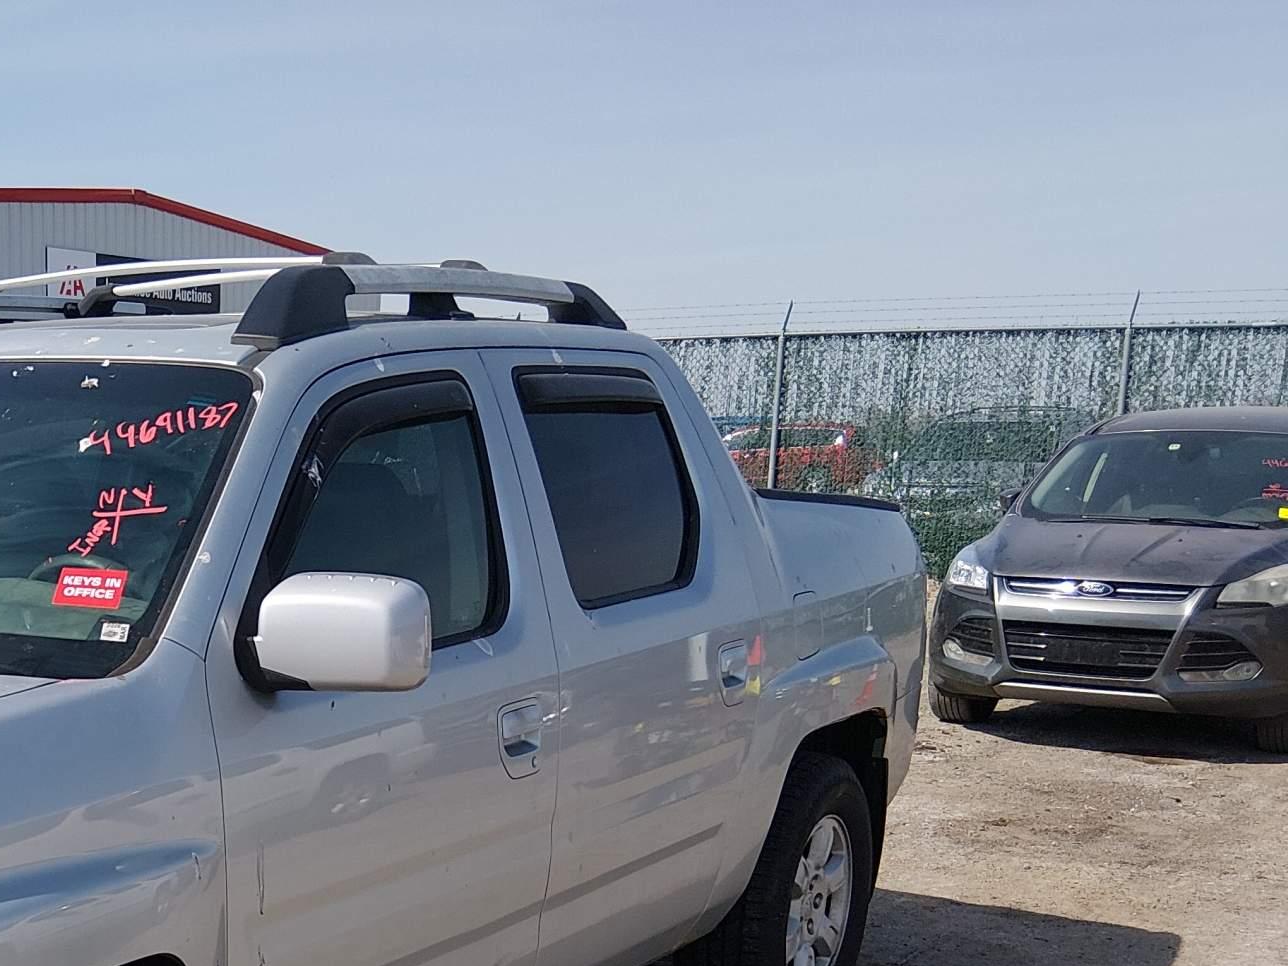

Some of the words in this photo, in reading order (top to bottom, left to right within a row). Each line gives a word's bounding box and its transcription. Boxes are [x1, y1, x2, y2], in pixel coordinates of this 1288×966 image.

[175, 287, 213, 304] Auctions
[89, 401, 239, 455] 44691187
[63, 575, 102, 587] KEYS
[104, 577, 122, 588] IN
[63, 586, 115, 600] OFFICE
